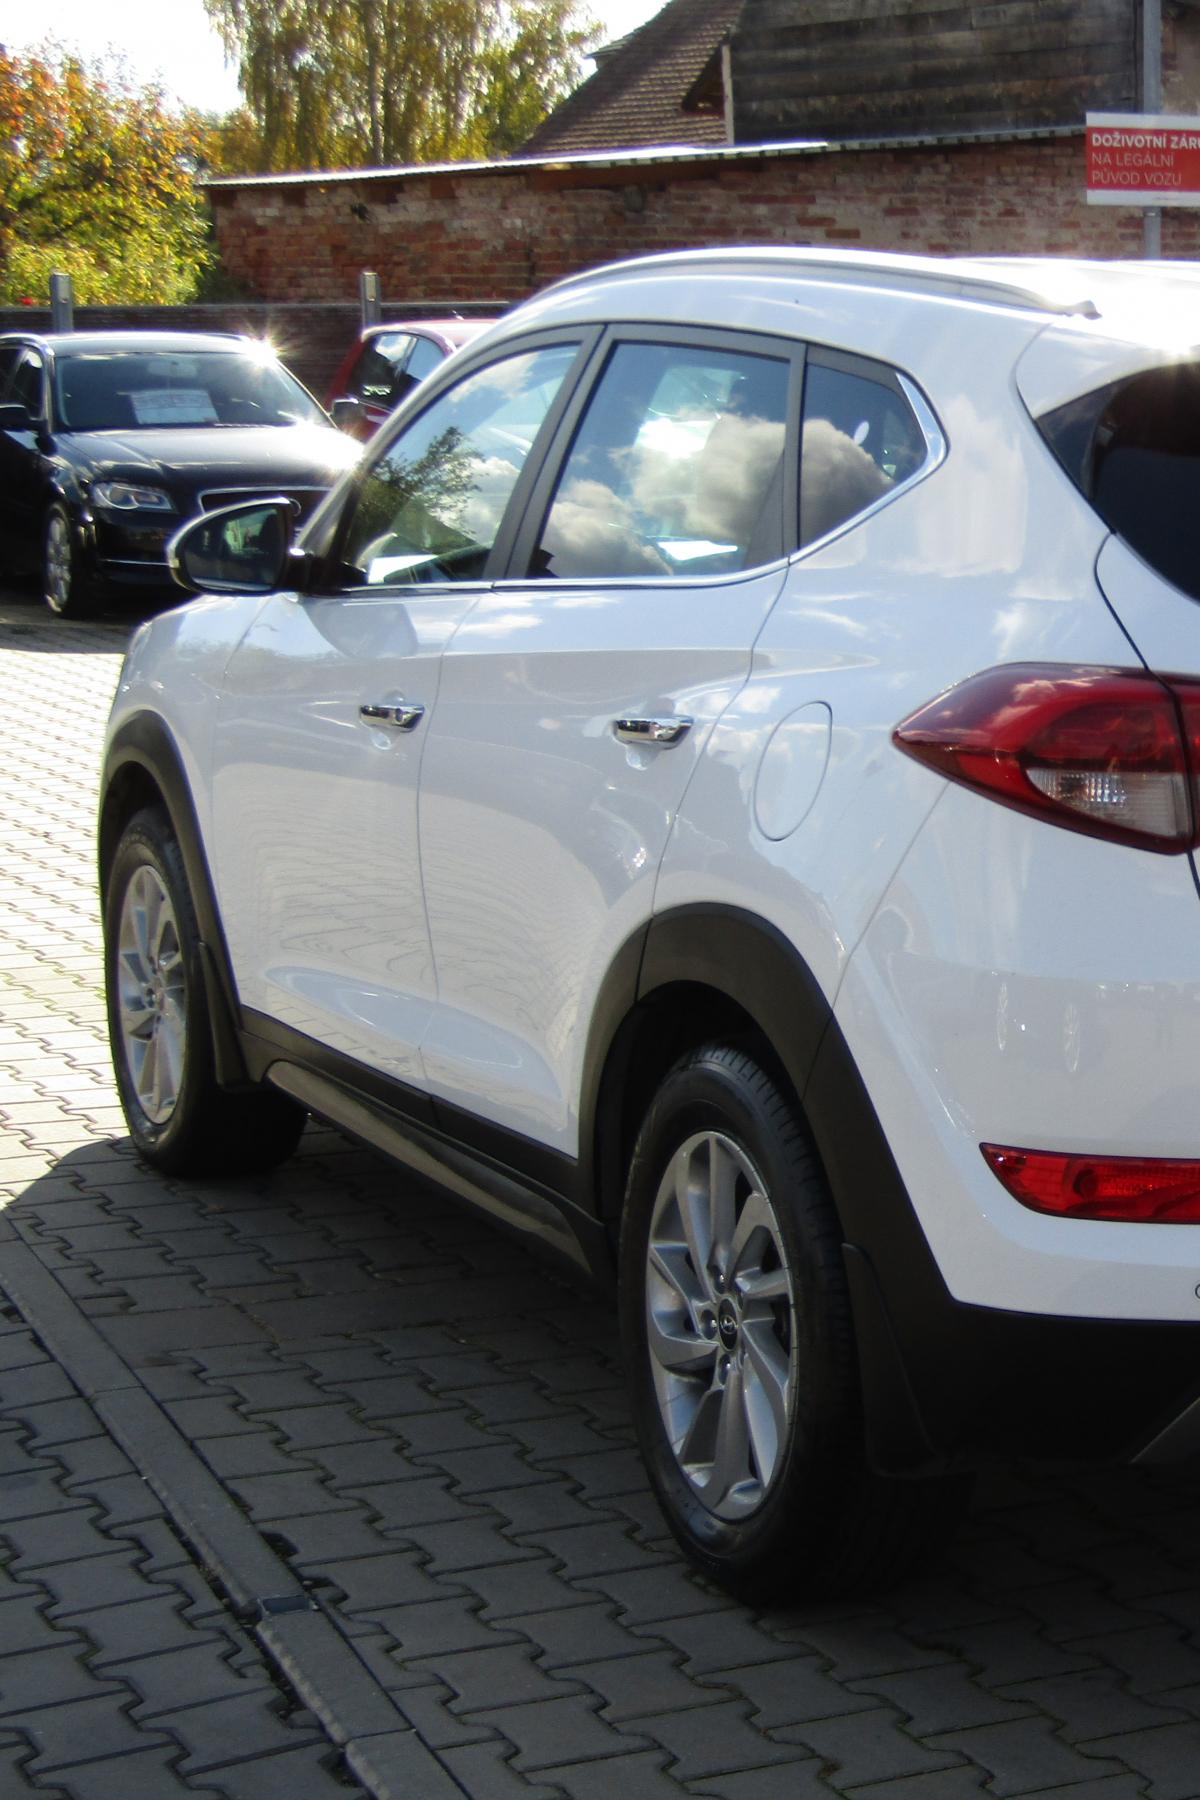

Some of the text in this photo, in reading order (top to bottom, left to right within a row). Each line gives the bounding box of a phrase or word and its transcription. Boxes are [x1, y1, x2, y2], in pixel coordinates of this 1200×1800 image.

[1092, 131, 1167, 148] DOŽIVOTNÍ
[1092, 152, 1174, 167] NA LEGÁLNÍ
[1092, 168, 1182, 186] PŮVOD VOZU
